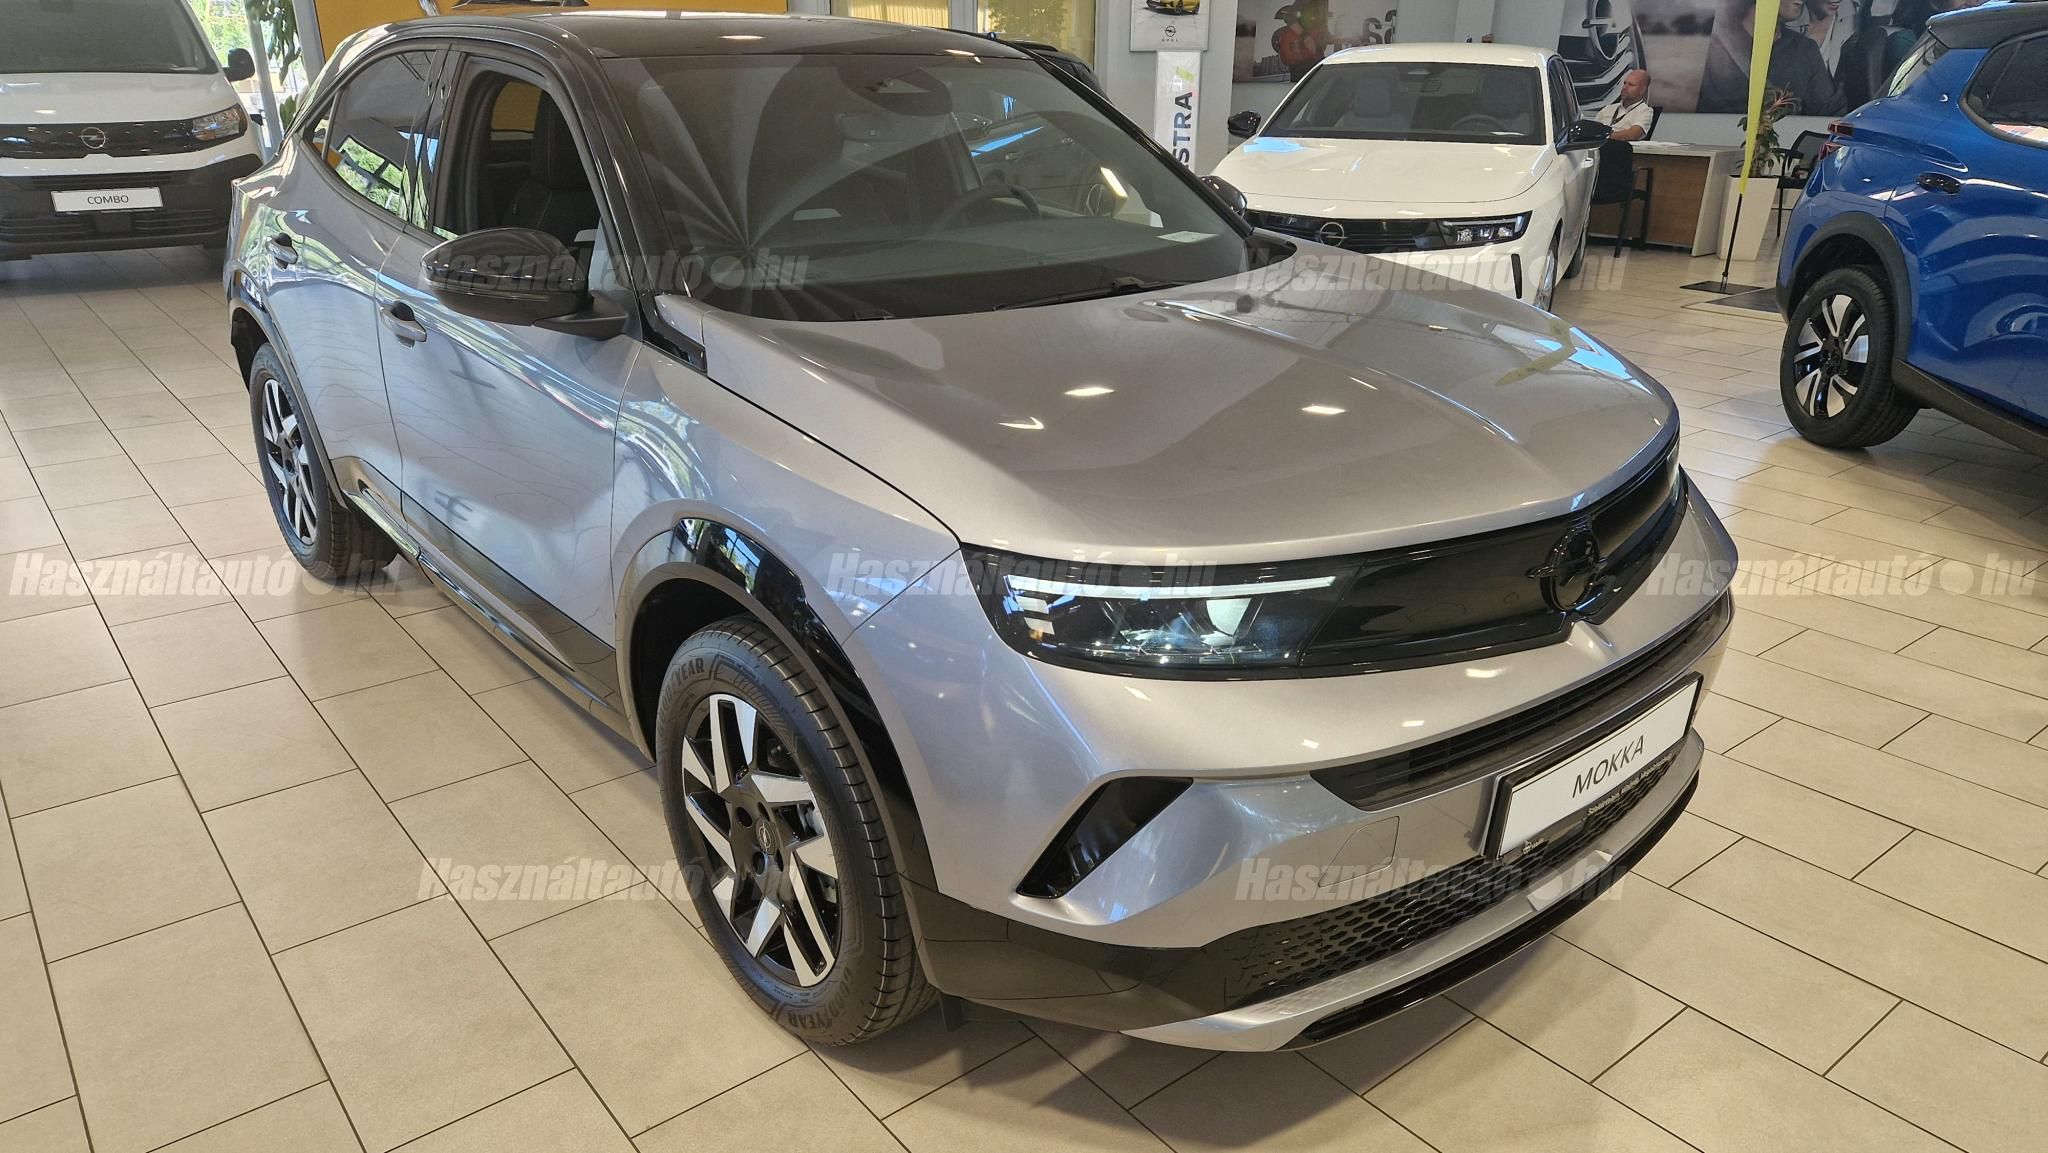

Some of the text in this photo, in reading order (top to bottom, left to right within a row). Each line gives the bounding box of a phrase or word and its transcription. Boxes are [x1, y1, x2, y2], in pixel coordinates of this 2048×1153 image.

[1172, 92, 1193, 169] STRA
[87, 195, 129, 205] COMBO
[1572, 735, 1644, 798] MOKKA
